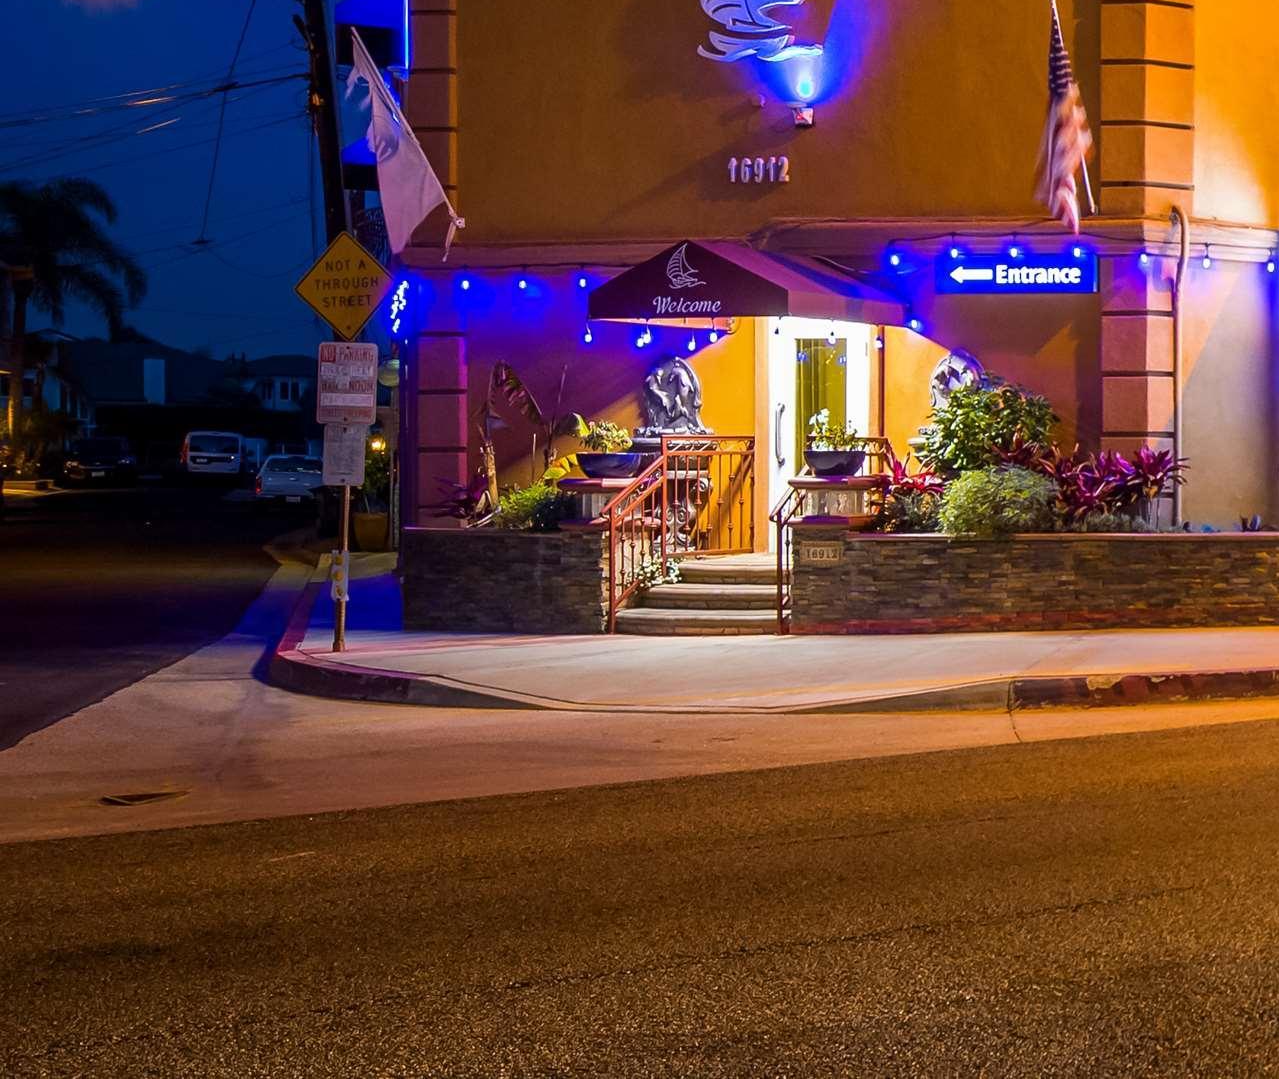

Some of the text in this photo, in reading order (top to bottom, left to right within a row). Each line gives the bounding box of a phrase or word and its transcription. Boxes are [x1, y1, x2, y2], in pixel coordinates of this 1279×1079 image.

[727, 155, 790, 183] 16912
[325, 260, 366, 273] NOT A
[995, 264, 1081, 284] Entrance
[314, 276, 379, 291] THROUGH
[323, 295, 372, 308] STREET
[652, 295, 722, 315] Welcome
[321, 345, 336, 362] NO
